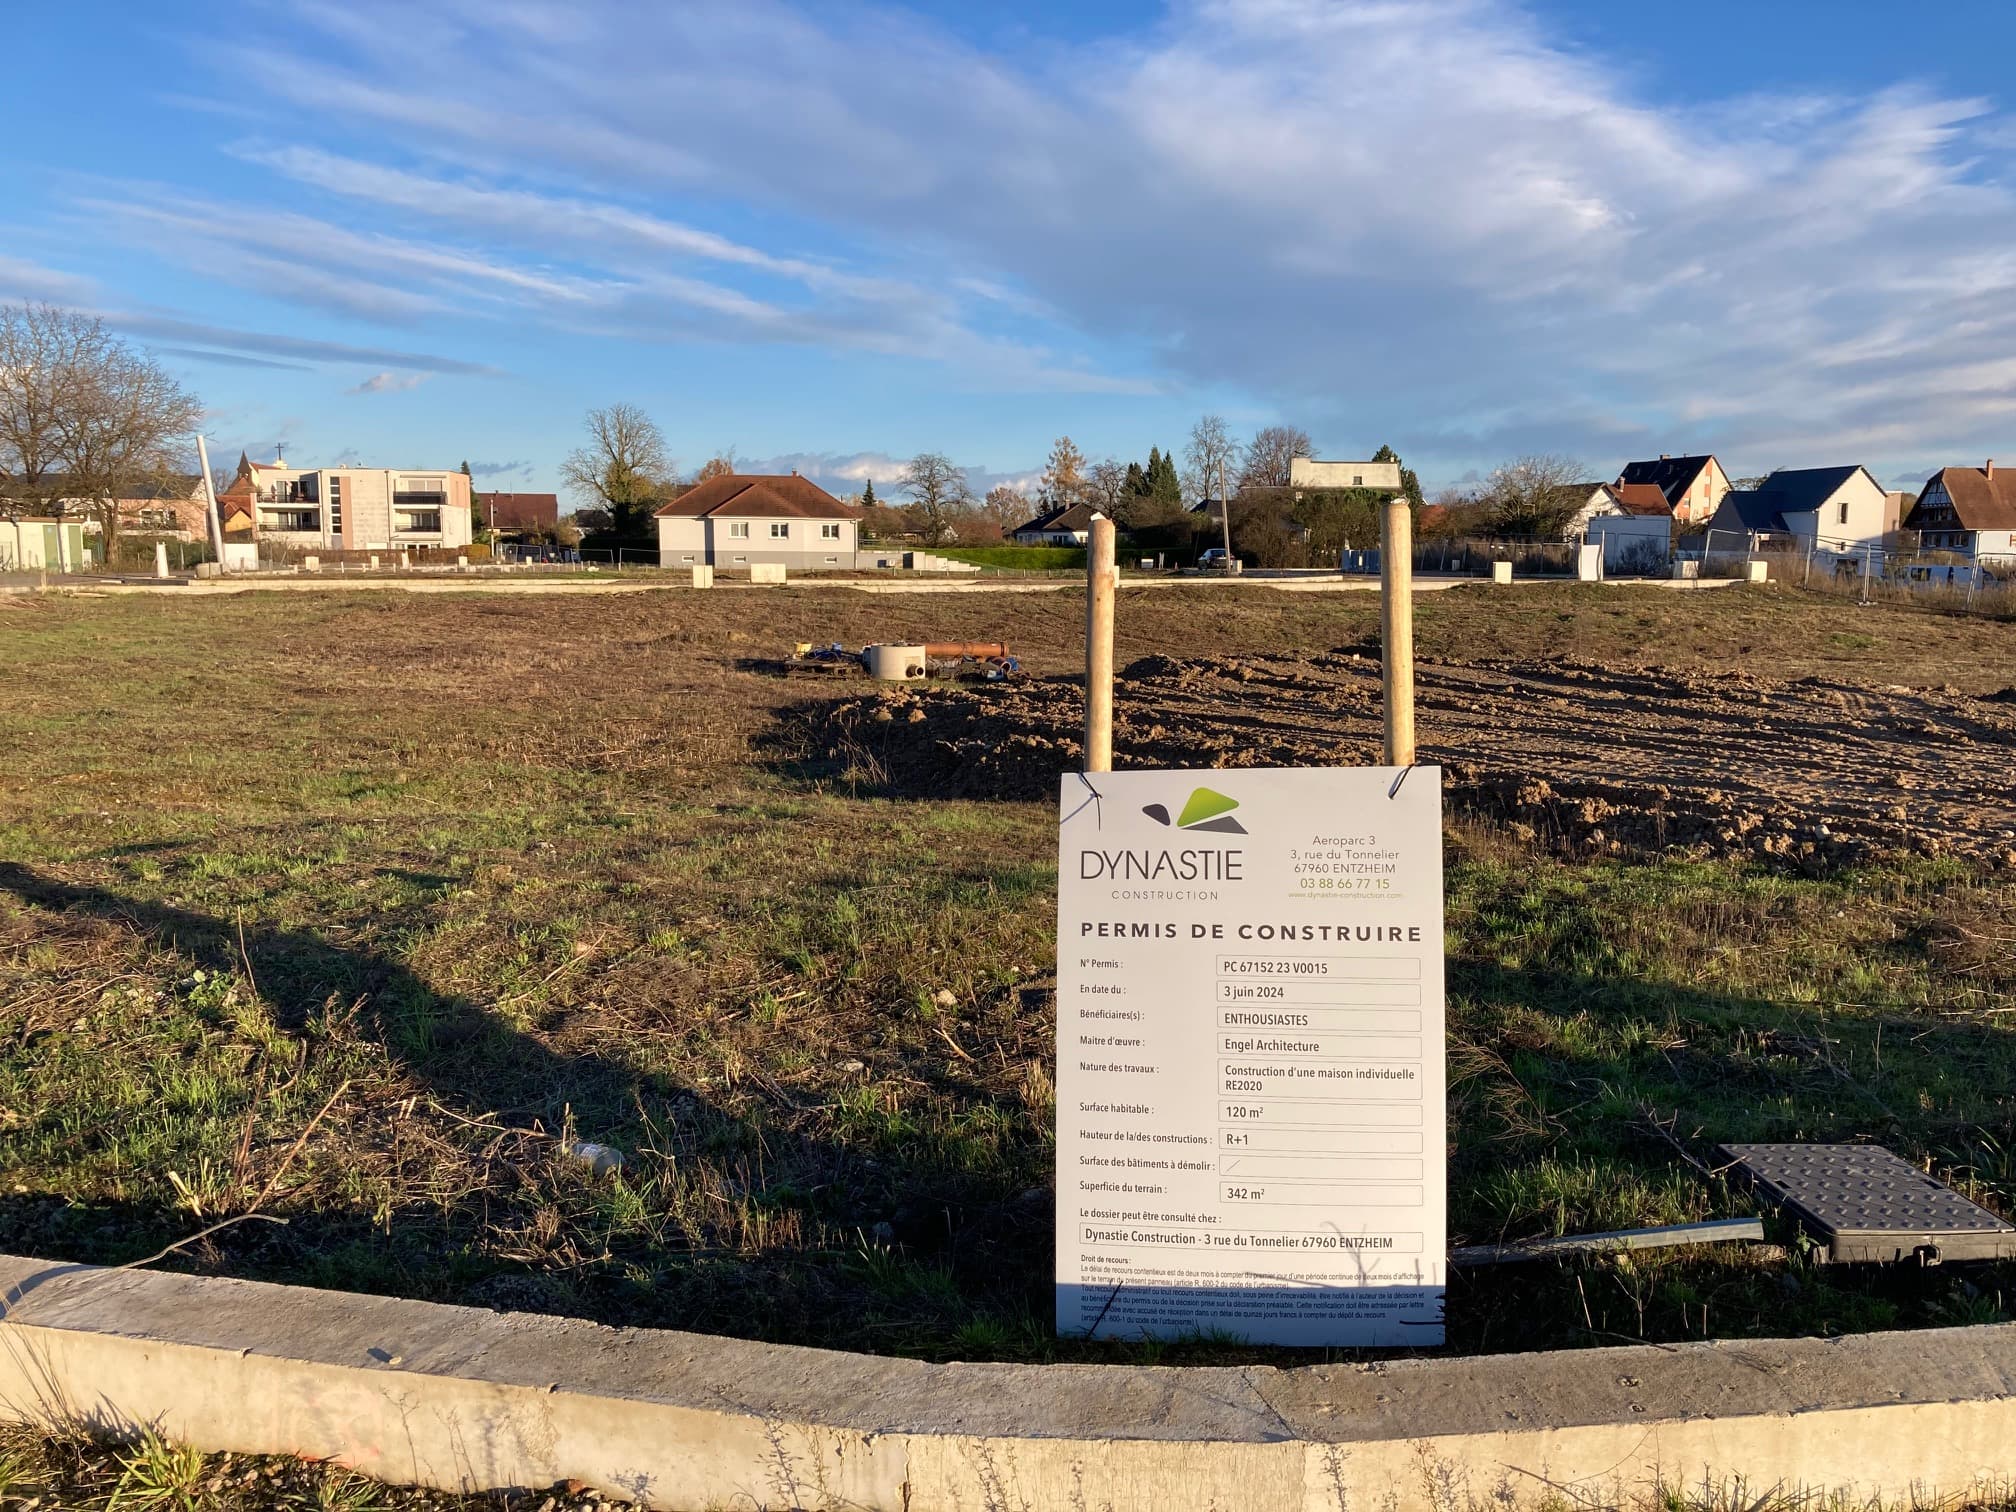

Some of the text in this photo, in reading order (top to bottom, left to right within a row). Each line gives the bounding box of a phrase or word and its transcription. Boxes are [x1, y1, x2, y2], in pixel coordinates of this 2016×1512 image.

[1313, 836, 1376, 848] Aeroparc 3
[1291, 849, 1300, 861] 3,
[1327, 849, 1342, 860] du
[1345, 849, 1400, 860] Tonnelier
[1081, 850, 1242, 880] DYNASTIE
[1295, 864, 1395, 873] 67960 ENTZHEIM
[1300, 878, 1389, 889] 03 88 66 77 15
[1112, 891, 1217, 902] CONSTRUCTION
[1082, 923, 1420, 941] PERMIS DE CONSTRUIRE
[1092, 959, 1119, 969] Permis
[1224, 962, 1328, 975] PC 67152 23 V0015
[1081, 984, 1089, 993] En
[1092, 984, 1108, 993] date
[1111, 985, 1121, 994] du
[1224, 986, 1284, 999] 3 juin 2024
[1080, 1009, 1140, 1021] Bénéficiaires(s)
[1225, 1013, 1307, 1025] ENTHOUSIASTES
[1080, 1036, 1105, 1045] Maitre
[1226, 1039, 1319, 1054] Engel Architecture
[1080, 1062, 1106, 1071] Nature
[1109, 1063, 1122, 1072] des
[1125, 1065, 1154, 1073] travaux
[1226, 1065, 1414, 1079] Construction d'une maison individuelle
[1226, 1080, 1262, 1091] RE2020
[1080, 1102, 1108, 1112] Surface
[1111, 1104, 1149, 1114] habitable
[1227, 1106, 1246, 1117] 120
[1080, 1130, 1112, 1139] Hauteur
[1114, 1131, 1124, 1140] de
[1127, 1132, 1150, 1141] la/des
[1153, 1135, 1207, 1144] constructions
[1227, 1134, 1247, 1145] R+1
[1080, 1156, 1109, 1167] Surface
[1111, 1157, 1125, 1167] des
[1128, 1158, 1169, 1169] bâtiments
[1171, 1160, 1176, 1169] à
[1178, 1160, 1211, 1171] démolir
[1080, 1181, 1119, 1192] Superficie
[1122, 1183, 1132, 1192] du
[1135, 1184, 1162, 1193] terrain
[1228, 1188, 1247, 1199] 342
[1080, 1208, 1088, 1217] Le
[1091, 1208, 1120, 1218] dossier
[1122, 1212, 1141, 1221] peut
[1143, 1211, 1159, 1220] être
[1161, 1213, 1196, 1222] consulté
[1198, 1214, 1216, 1223] chez
[1085, 1228, 1128, 1242] Dynastie
[1131, 1231, 1196, 1244] Construction
[1205, 1234, 1210, 1244] 3
[1214, 1237, 1231, 1245] rue
[1234, 1235, 1246, 1246] du
[1250, 1236, 1299, 1247] Tonnelier
[1302, 1236, 1337, 1248] 67960
[1340, 1236, 1392, 1250] ENTZHEIM
[1081, 1255, 1096, 1263] Droit
[1097, 1255, 1105, 1263] de
[1106, 1257, 1128, 1265] recours
